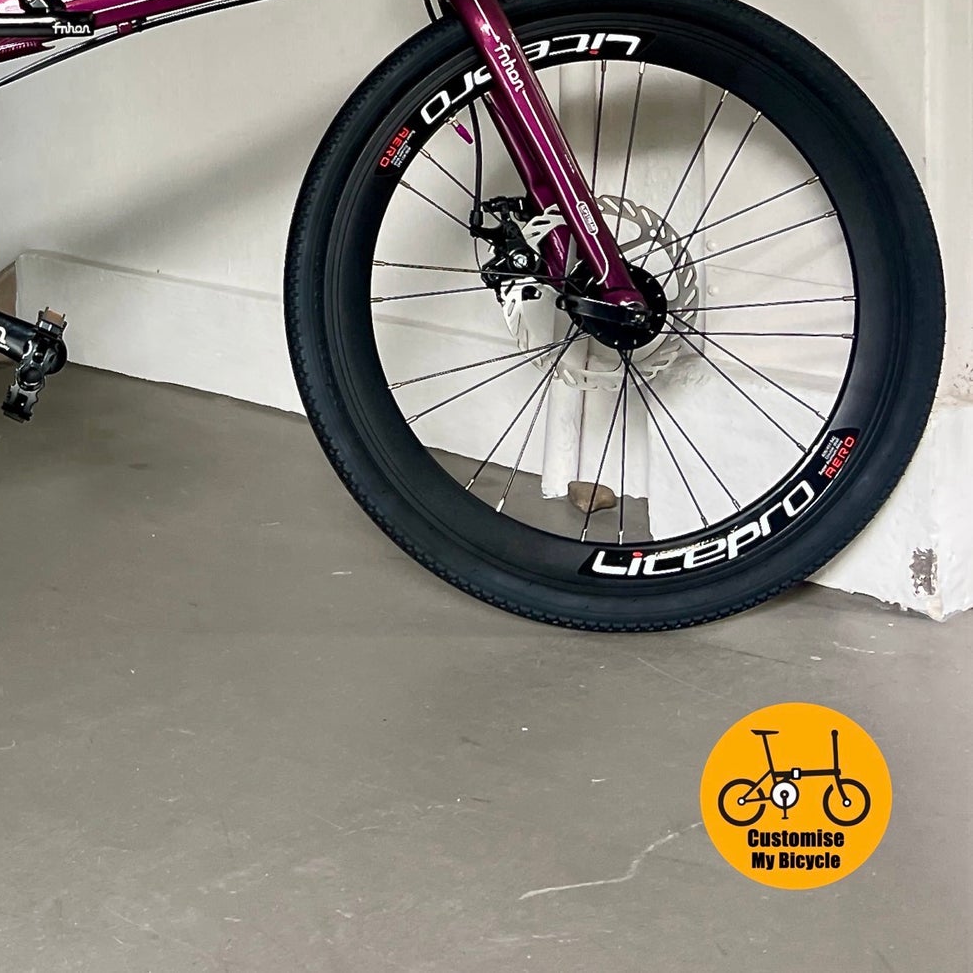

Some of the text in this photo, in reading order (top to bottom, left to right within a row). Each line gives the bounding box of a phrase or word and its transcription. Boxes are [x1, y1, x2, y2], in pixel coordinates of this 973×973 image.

[52, 21, 91, 34] fnhon
[494, 41, 524, 93] fnhon
[380, 127, 410, 167] AERO
[825, 436, 855, 478] AERO
